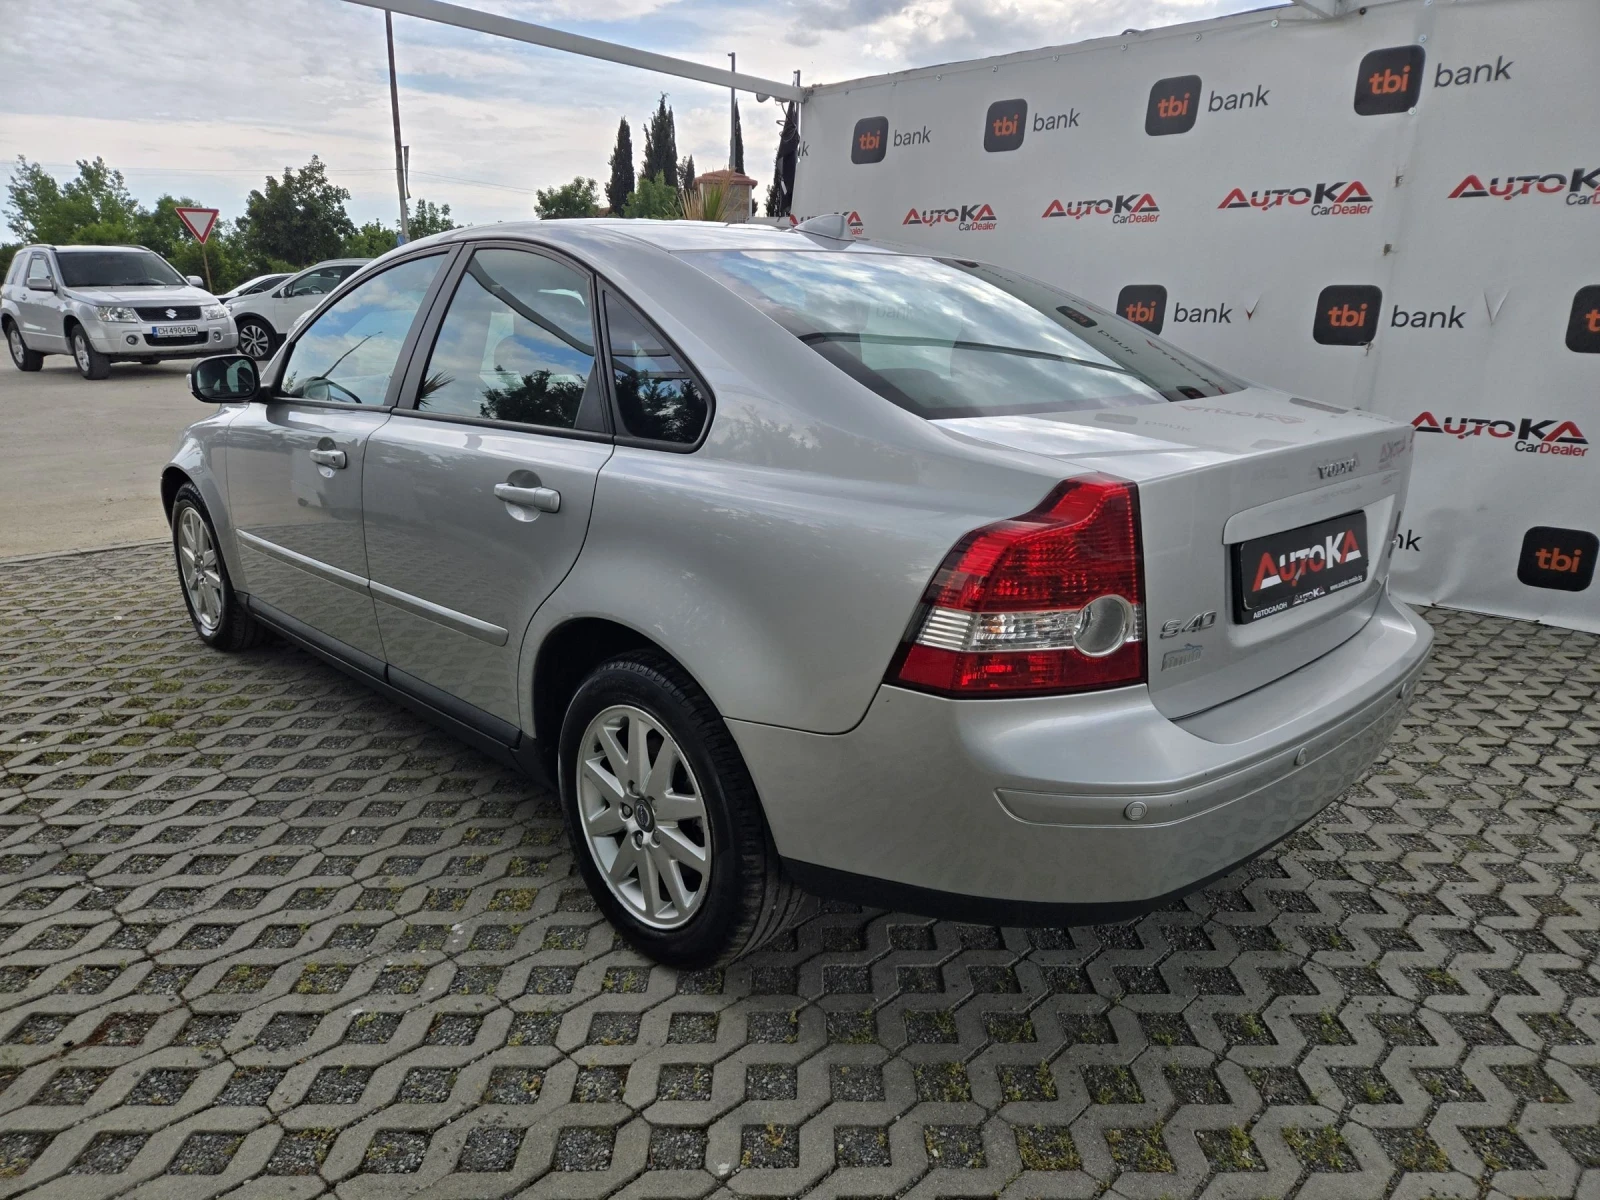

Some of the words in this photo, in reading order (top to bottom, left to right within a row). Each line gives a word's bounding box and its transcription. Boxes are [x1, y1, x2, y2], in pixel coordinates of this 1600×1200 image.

[1369, 65, 1411, 95] tbi
[1433, 55, 1514, 88] bank
[1158, 92, 1190, 118] tbi
[1207, 84, 1270, 112] bank
[993, 115, 1018, 136] tbi
[1032, 108, 1080, 132] bank
[859, 131, 880, 149] tbi
[893, 126, 931, 147] bank
[1112, 212, 1160, 224] CarDealer
[1310, 203, 1373, 216] CarDealer
[958, 221, 997, 231] CarDealer
[1126, 301, 1156, 323] tbi
[1173, 302, 1233, 324] bank
[1328, 303, 1368, 328] tbi
[1390, 305, 1466, 329] bank
[169, 327, 186, 335] 4904
[1514, 440, 1590, 457] CarDealer
[1535, 547, 1583, 573] tbi
[1159, 609, 1217, 639] S40
